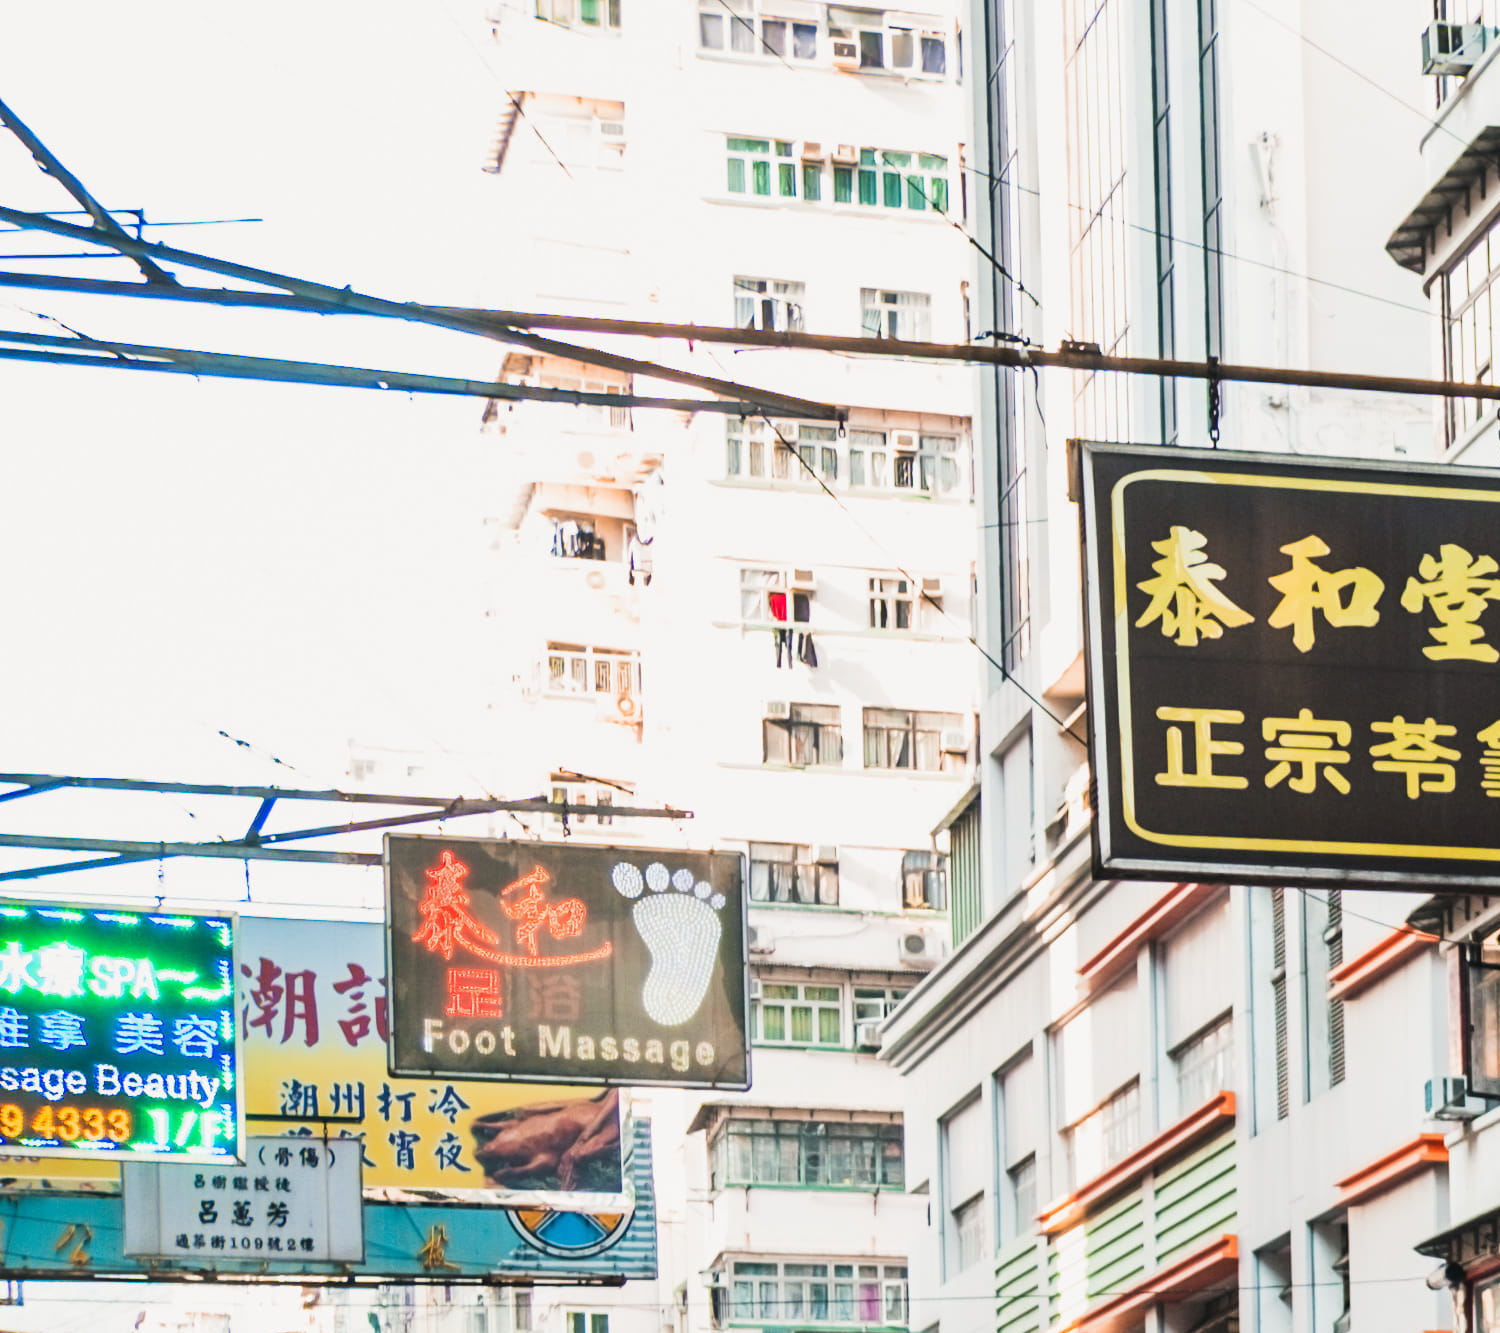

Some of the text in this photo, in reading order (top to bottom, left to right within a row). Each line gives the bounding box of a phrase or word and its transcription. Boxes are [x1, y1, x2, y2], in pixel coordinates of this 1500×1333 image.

[114, 1012, 219, 1059] 美容
[422, 1018, 716, 1073] Foot Massage
[95, 1063, 220, 1109] Beauty
[280, 1079, 472, 1124] 潮州打冷
